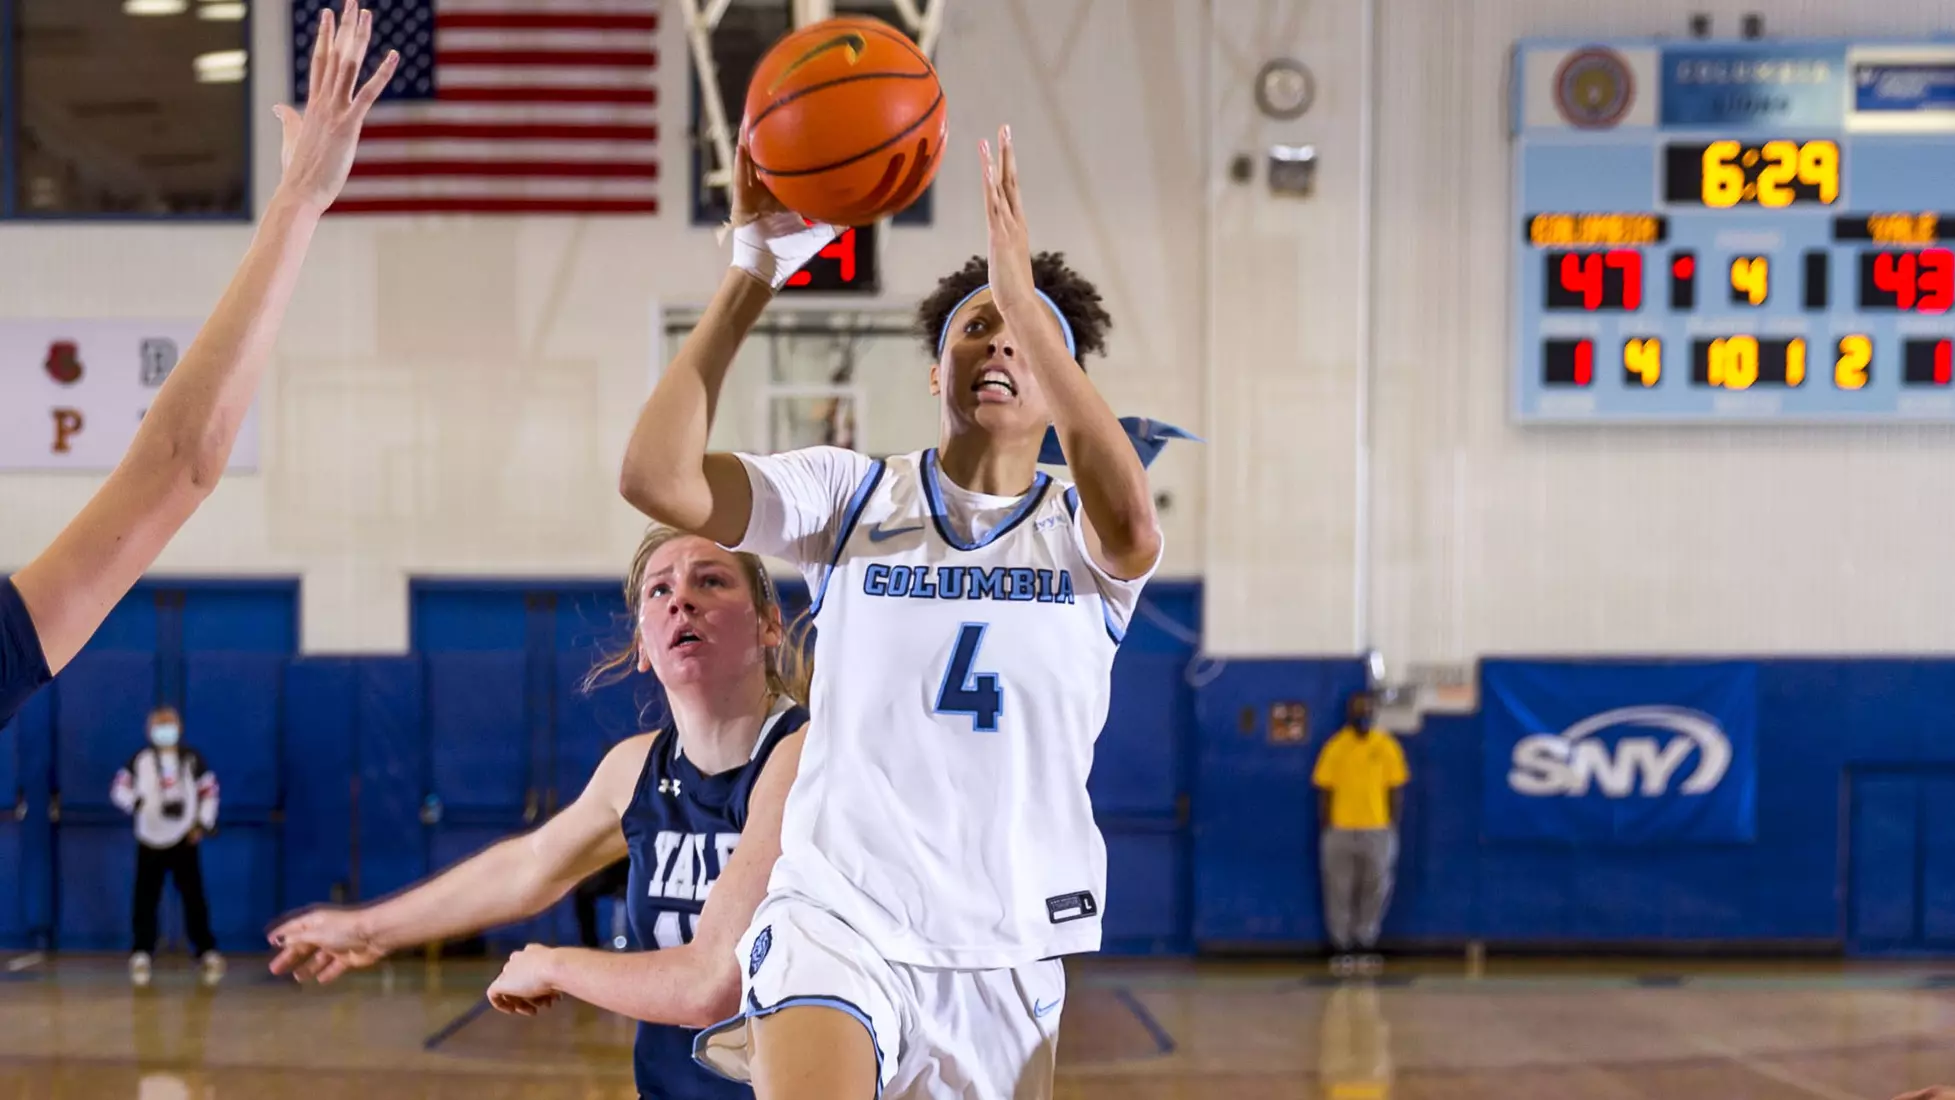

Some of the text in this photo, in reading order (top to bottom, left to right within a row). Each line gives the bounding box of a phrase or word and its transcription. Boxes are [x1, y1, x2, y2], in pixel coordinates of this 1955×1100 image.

[1702, 140, 1840, 208] 6:29
[1561, 250, 1642, 311] 47
[1731, 256, 1768, 305] 4
[1874, 248, 1955, 313] 43
[1574, 339, 1593, 386] 1
[1624, 338, 1661, 386] 4
[1708, 335, 1806, 389] 10 1
[1835, 335, 1873, 389] 2
[1934, 338, 1953, 385] 1
[51, 408, 83, 453] P
[863, 563, 1075, 604] COLUMBIA
[933, 622, 1004, 732] 4
[1507, 731, 1698, 798] SNY
[1084, 898, 1092, 910] L
